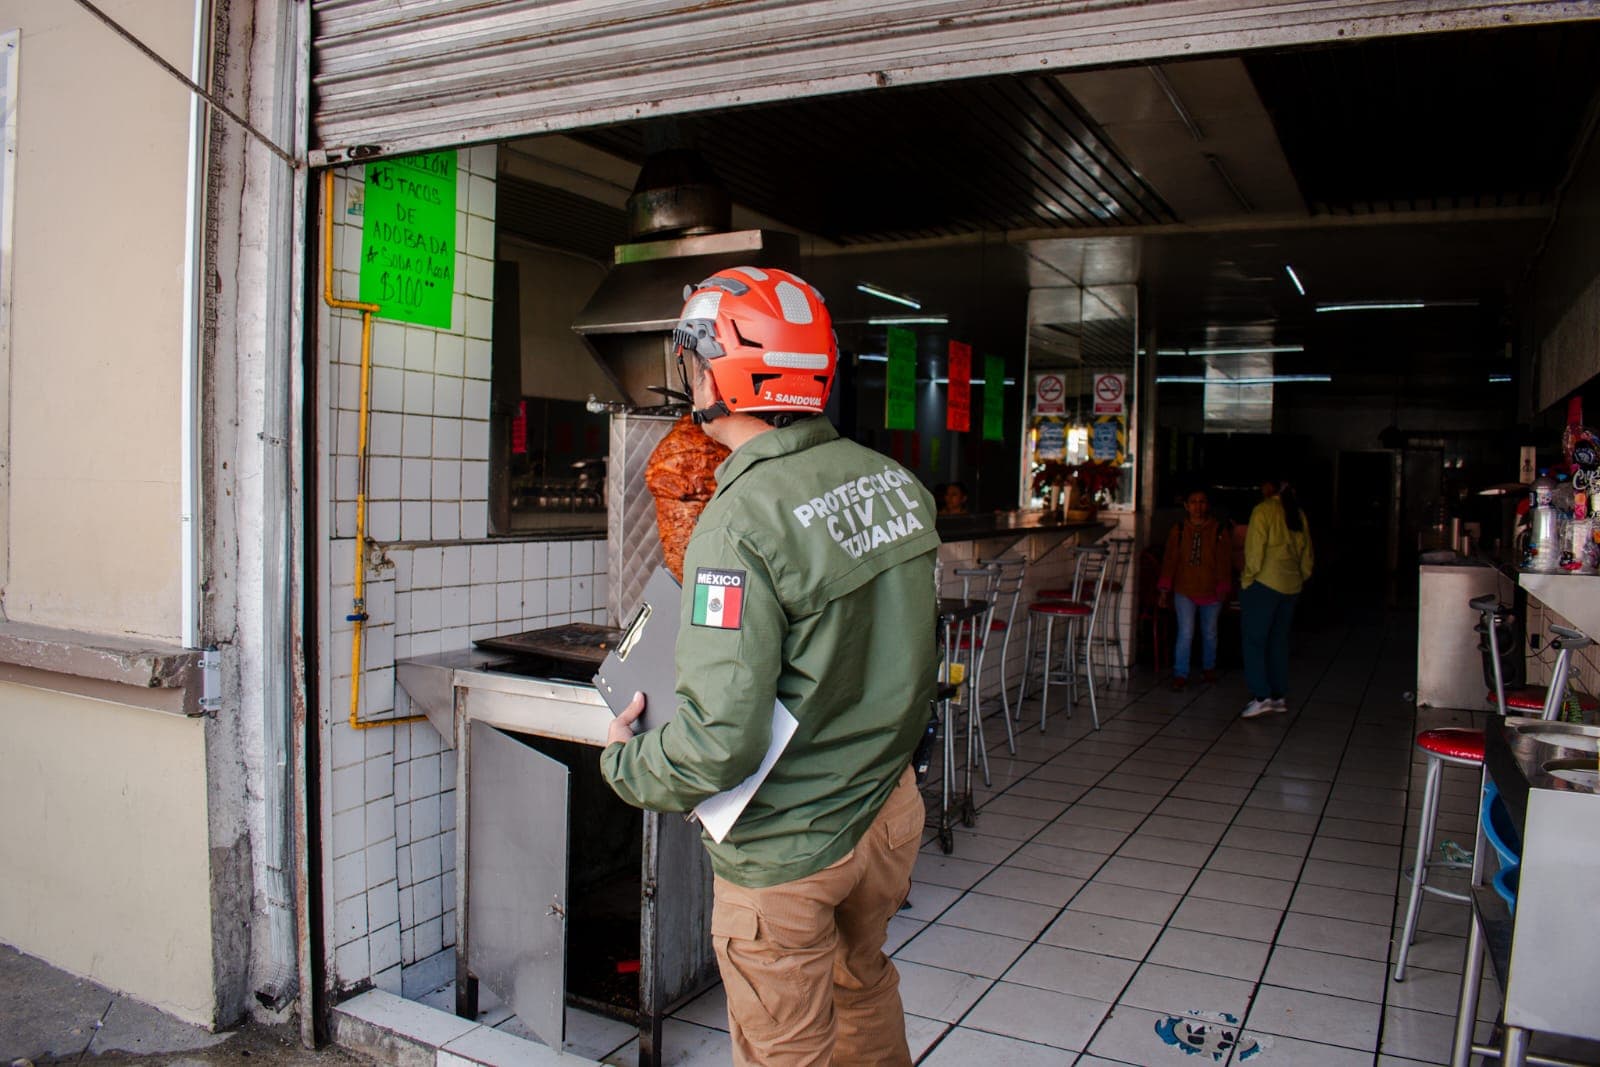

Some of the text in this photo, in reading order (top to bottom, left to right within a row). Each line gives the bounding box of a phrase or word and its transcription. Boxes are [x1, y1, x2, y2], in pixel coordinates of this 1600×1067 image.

[383, 168, 441, 205] 5 TACOS
[396, 203, 416, 224] DE
[373, 220, 448, 257] ADOBADA
[793, 465, 913, 528] PROTECCIÓN
[827, 488, 919, 542] CIVIL
[697, 572, 741, 586] MÉXICO
